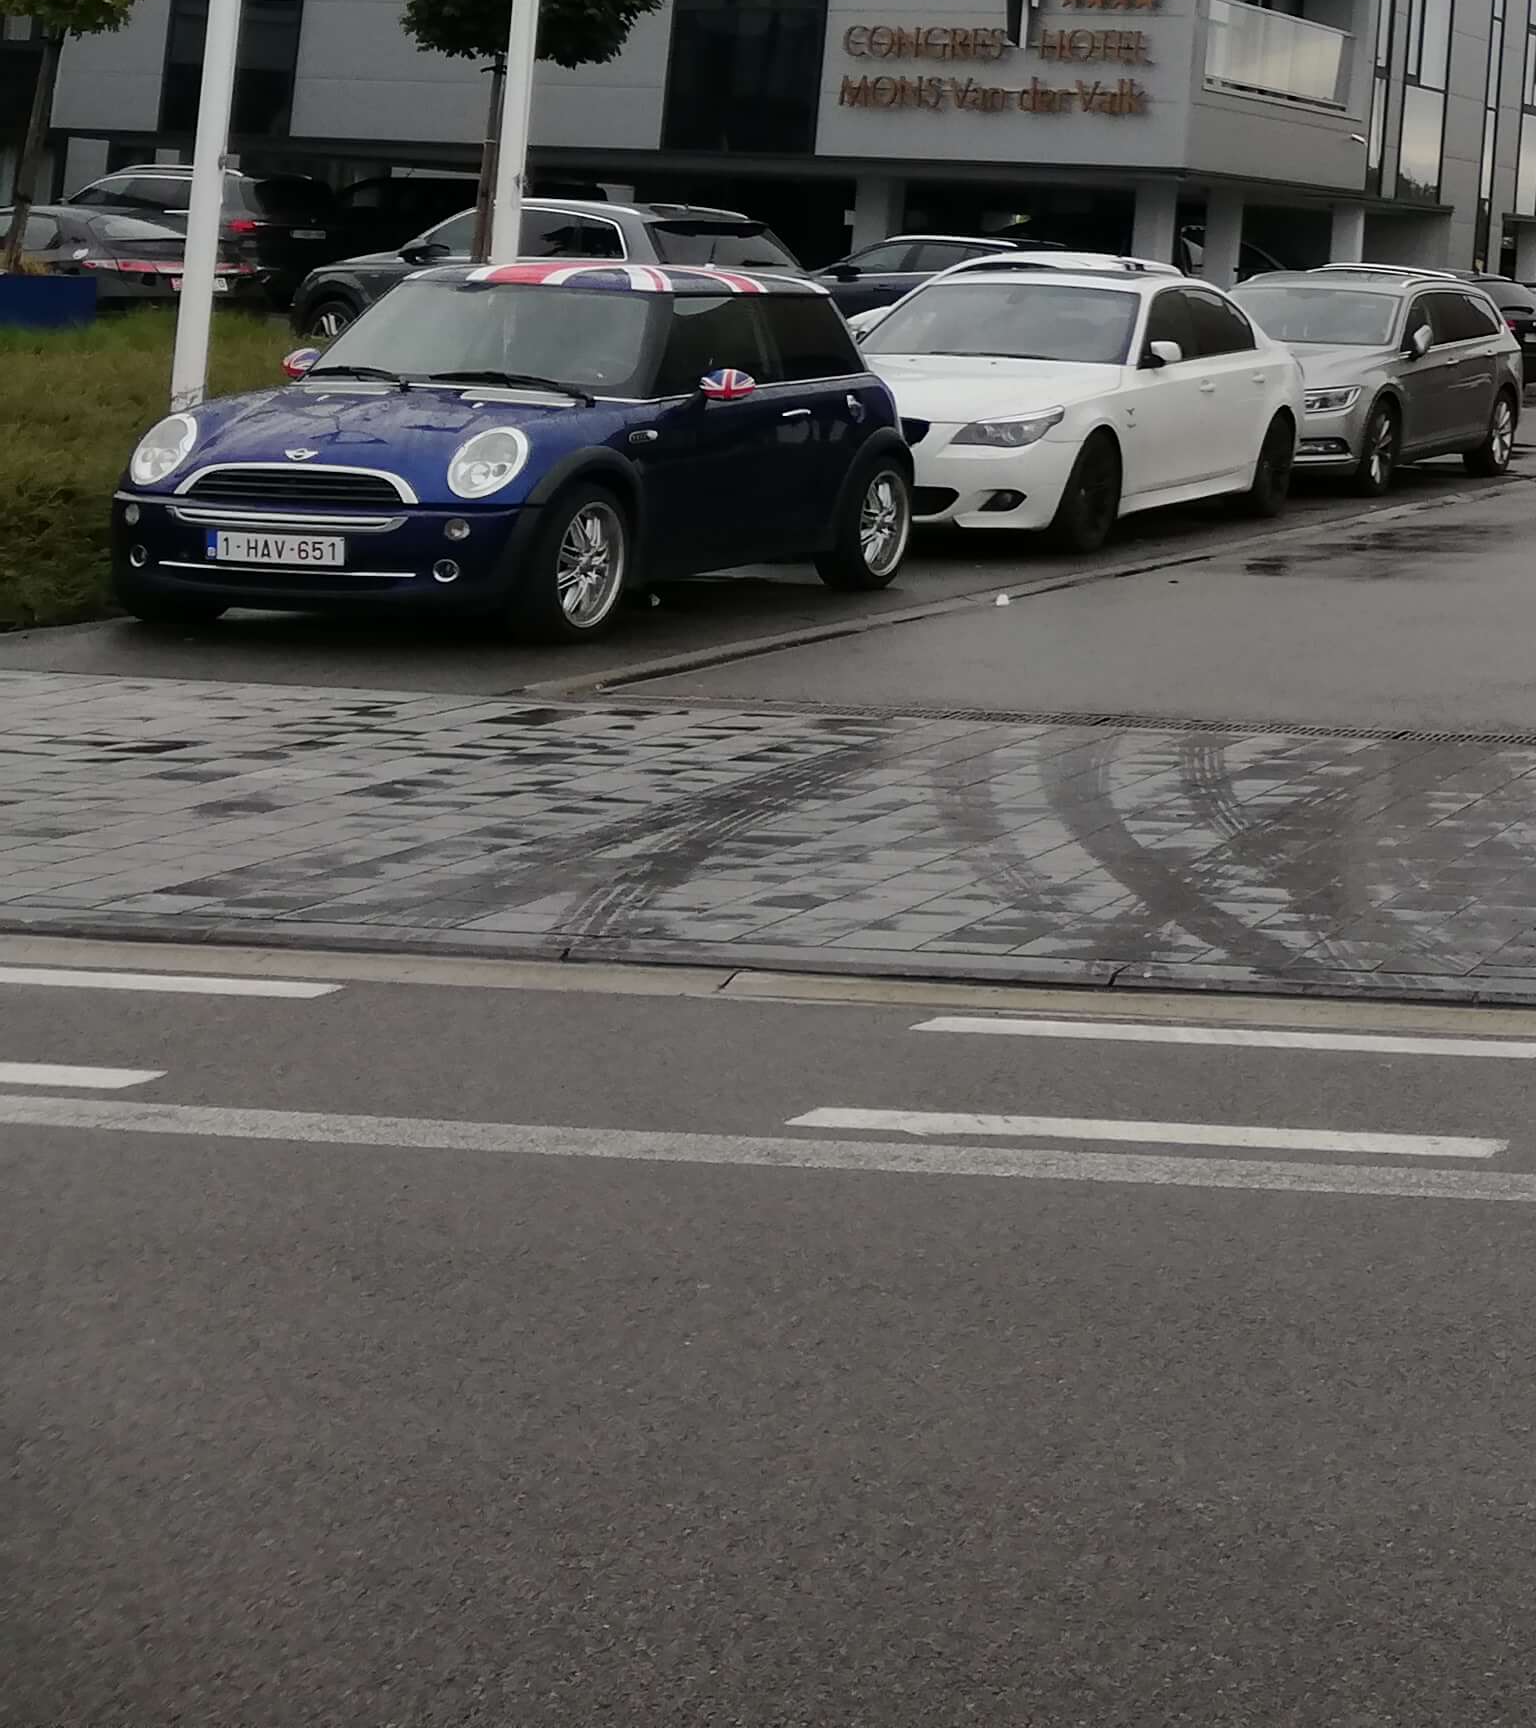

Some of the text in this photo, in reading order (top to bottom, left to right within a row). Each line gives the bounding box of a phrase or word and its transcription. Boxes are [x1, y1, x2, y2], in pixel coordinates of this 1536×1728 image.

[843, 26, 1150, 62] CONGRES HOTEL
[838, 75, 1146, 113] MONS Van der Valk
[223, 535, 337, 562] 1-HAV-651
